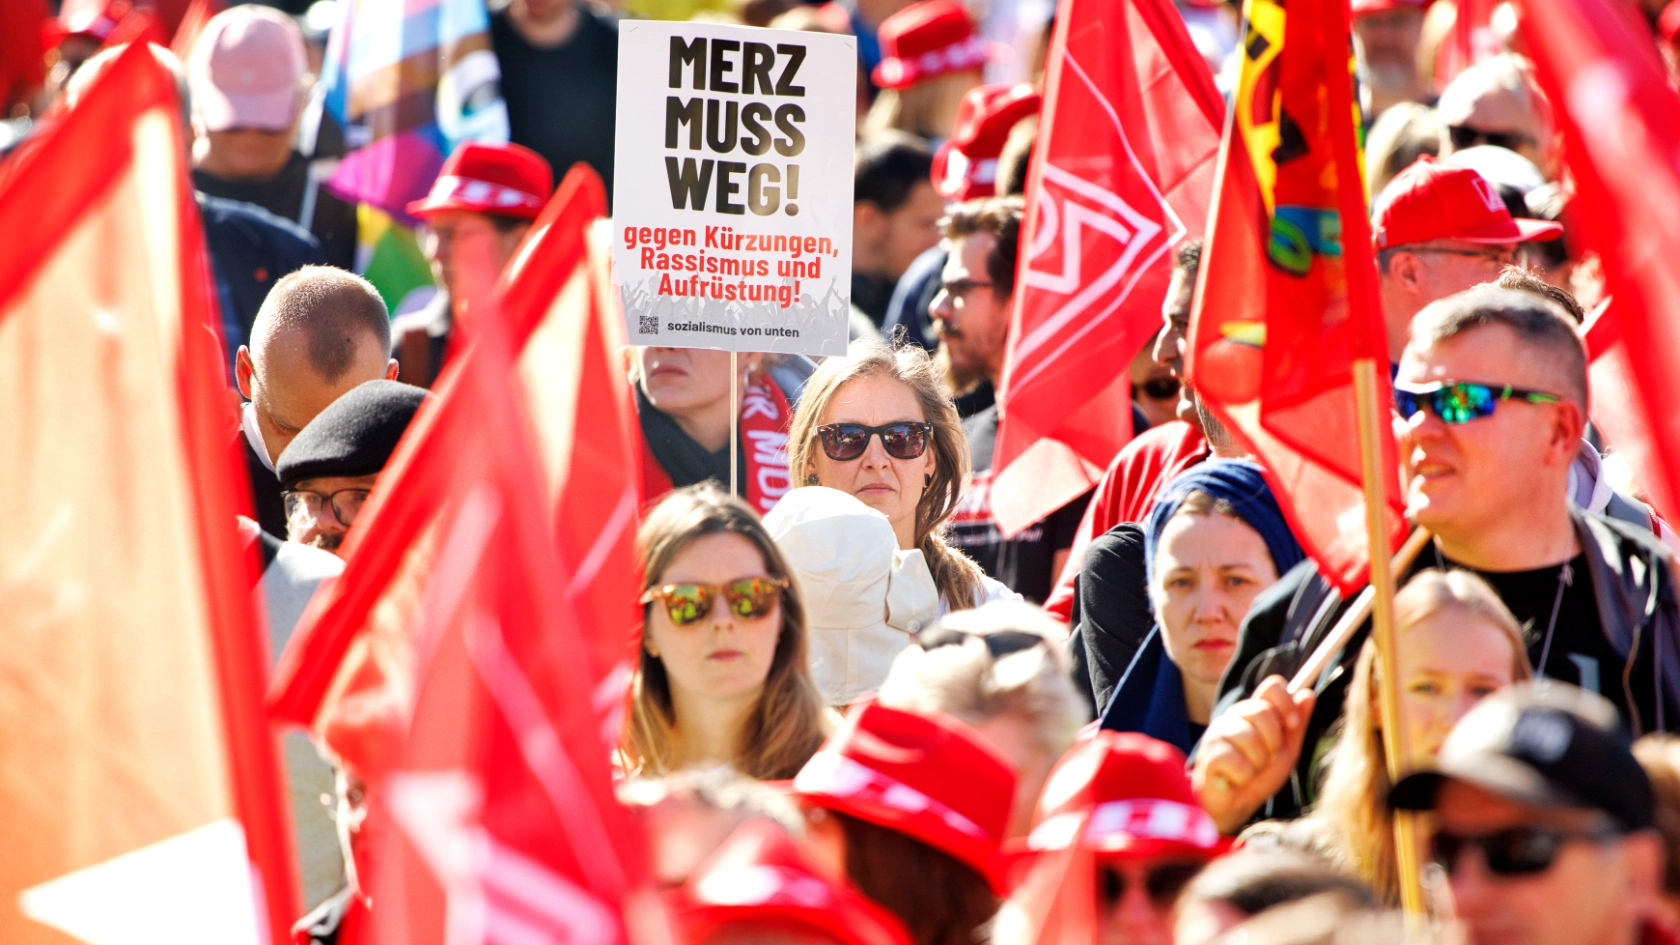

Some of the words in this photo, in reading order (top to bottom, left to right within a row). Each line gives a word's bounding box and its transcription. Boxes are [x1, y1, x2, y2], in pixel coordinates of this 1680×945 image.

[668, 35, 807, 97] MERZ
[664, 96, 806, 157] MUSS
[664, 156, 801, 217] WEG!
[623, 226, 697, 251] gegen
[704, 225, 839, 258] Kürzungen,
[640, 246, 770, 277] Rassismus
[777, 257, 822, 279] und
[657, 273, 801, 308] Aufrüstung!
[667, 320, 738, 335] sozialismus
[739, 326, 763, 336] von
[764, 327, 800, 338] unten
